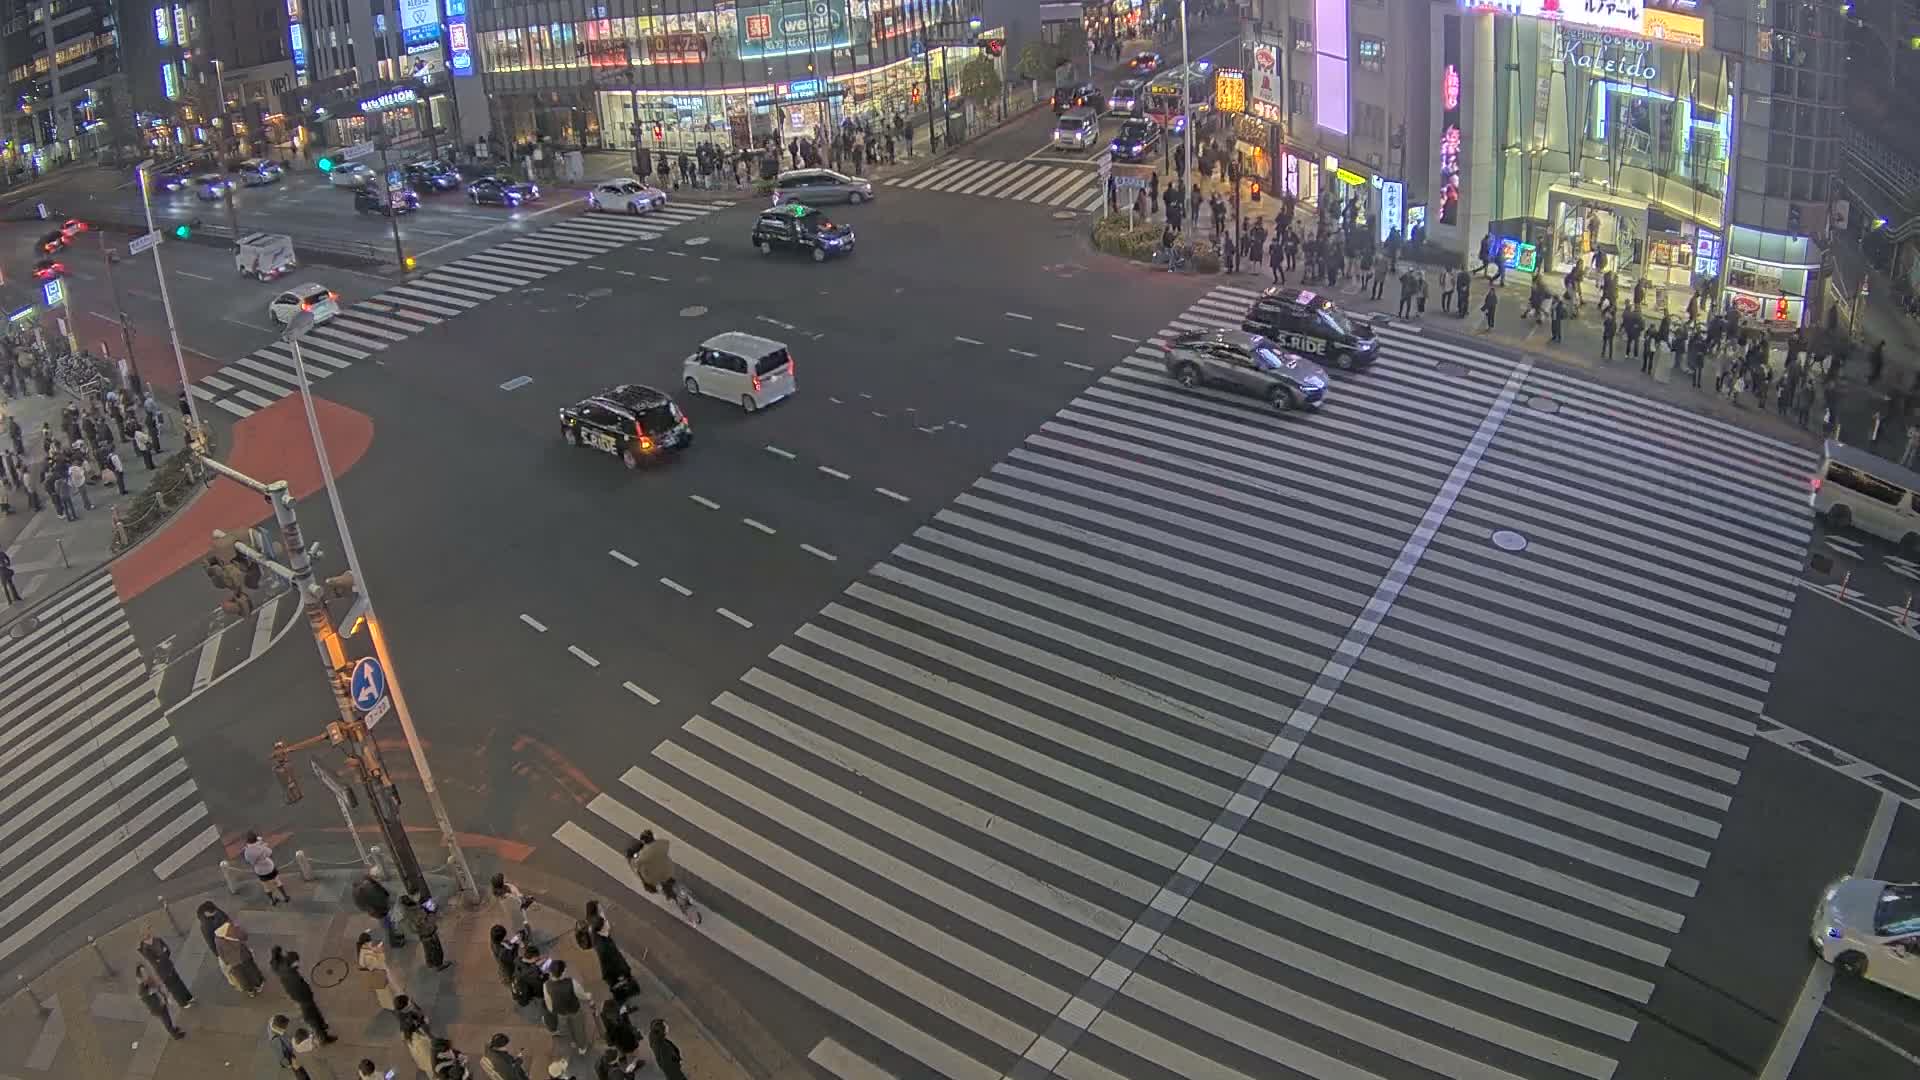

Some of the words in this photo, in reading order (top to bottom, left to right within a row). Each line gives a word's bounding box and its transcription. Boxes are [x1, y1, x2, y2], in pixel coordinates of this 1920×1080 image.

[1625, 39, 1652, 51] SLOT
[1562, 39, 1655, 79] Kaleido
[1278, 334, 1328, 356] S.RIDE
[580, 427, 617, 456] S.RIDE
